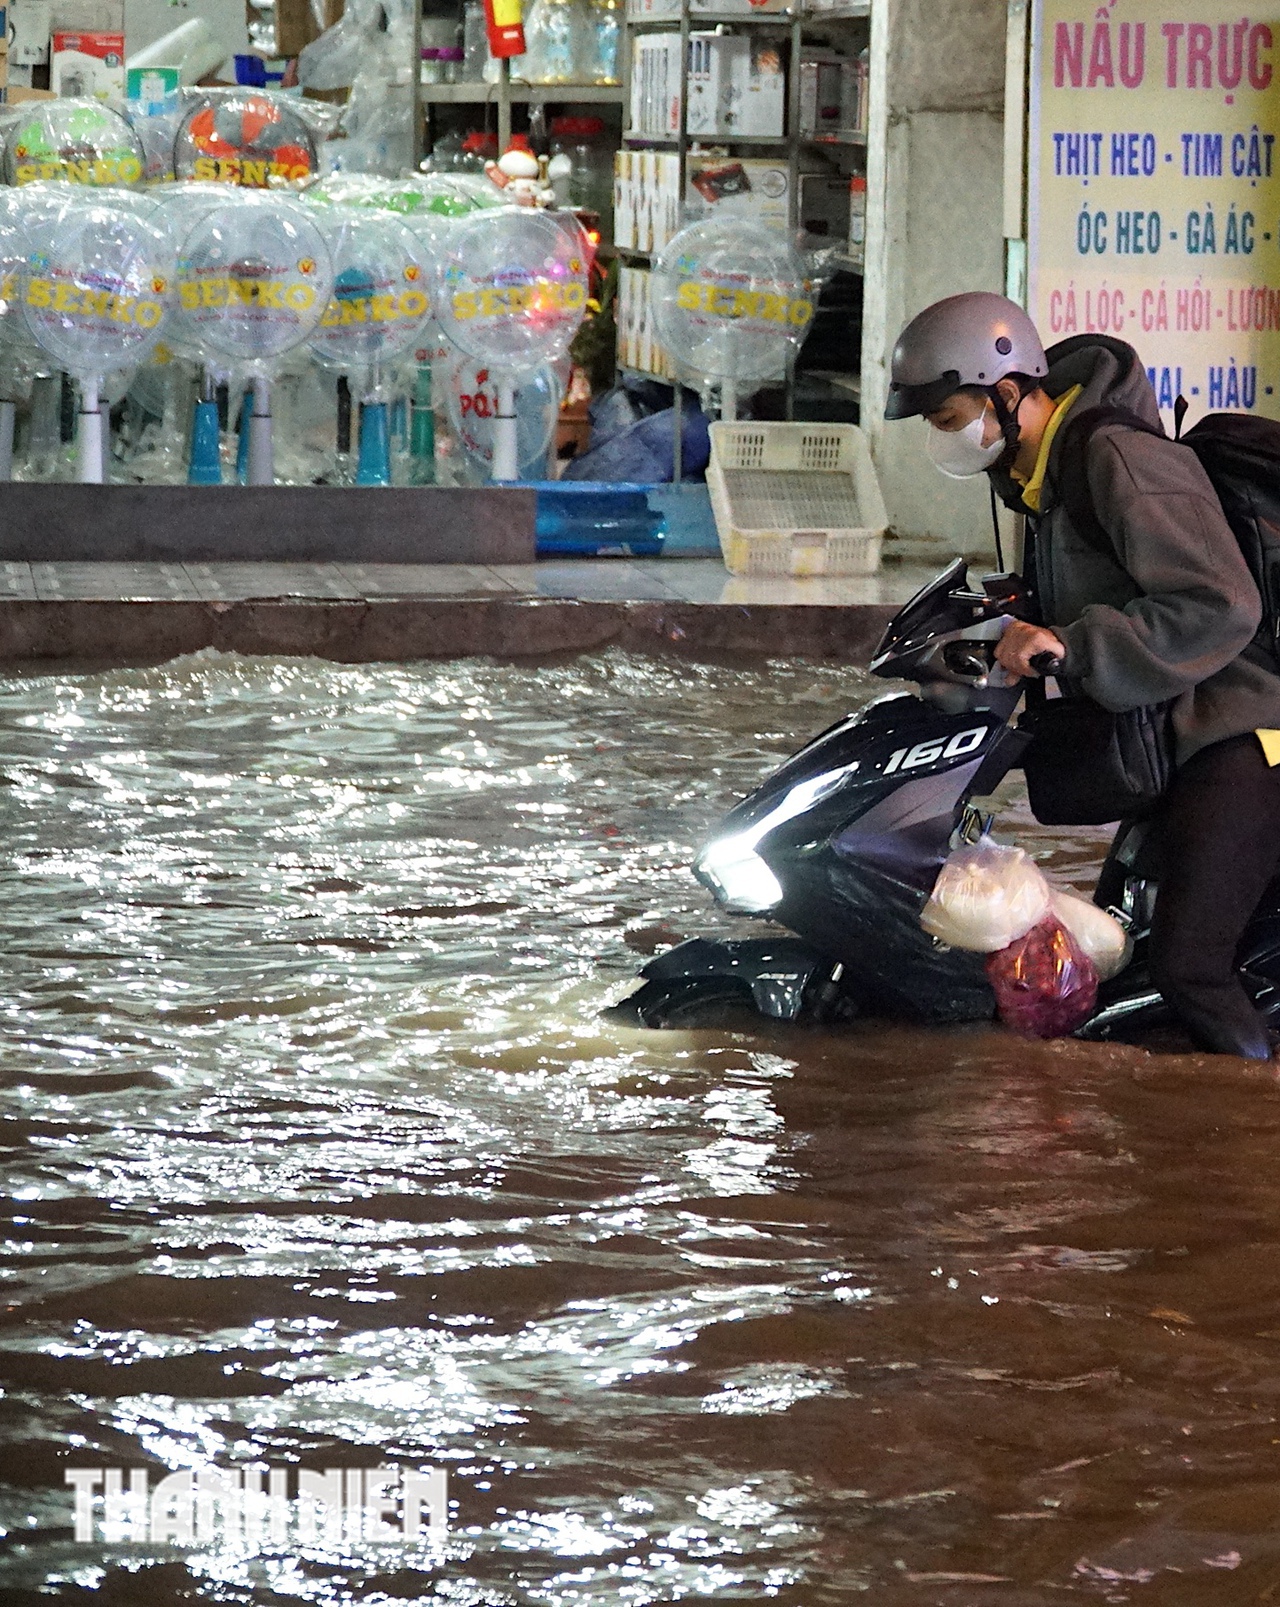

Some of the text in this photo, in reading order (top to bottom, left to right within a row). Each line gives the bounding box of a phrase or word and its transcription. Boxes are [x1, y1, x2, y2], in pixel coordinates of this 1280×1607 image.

[1054, 0, 1145, 89] NẤU
[1161, 17, 1273, 105] TRỰC
[1053, 132, 1103, 186] THỊT
[1111, 132, 1156, 176] HEO
[1181, 133, 1222, 176] TIM
[1232, 124, 1275, 187] CẬT
[1077, 202, 1107, 255] ÓC
[1116, 211, 1161, 254] HEO
[1186, 202, 1216, 254] GÀ
[1224, 202, 1254, 254] ÁC
[26, 276, 163, 328] SENKO
[179, 279, 316, 312] SENKO
[320, 290, 428, 327] ENKO
[453, 281, 583, 319] SENKO
[677, 282, 813, 326] SENKO
[1050, 280, 1077, 332] CÁ
[1085, 280, 1124, 332] LÓC
[1142, 280, 1168, 331] CÁ
[1209, 356, 1256, 409] HÀU
[883, 726, 988, 775] 160
